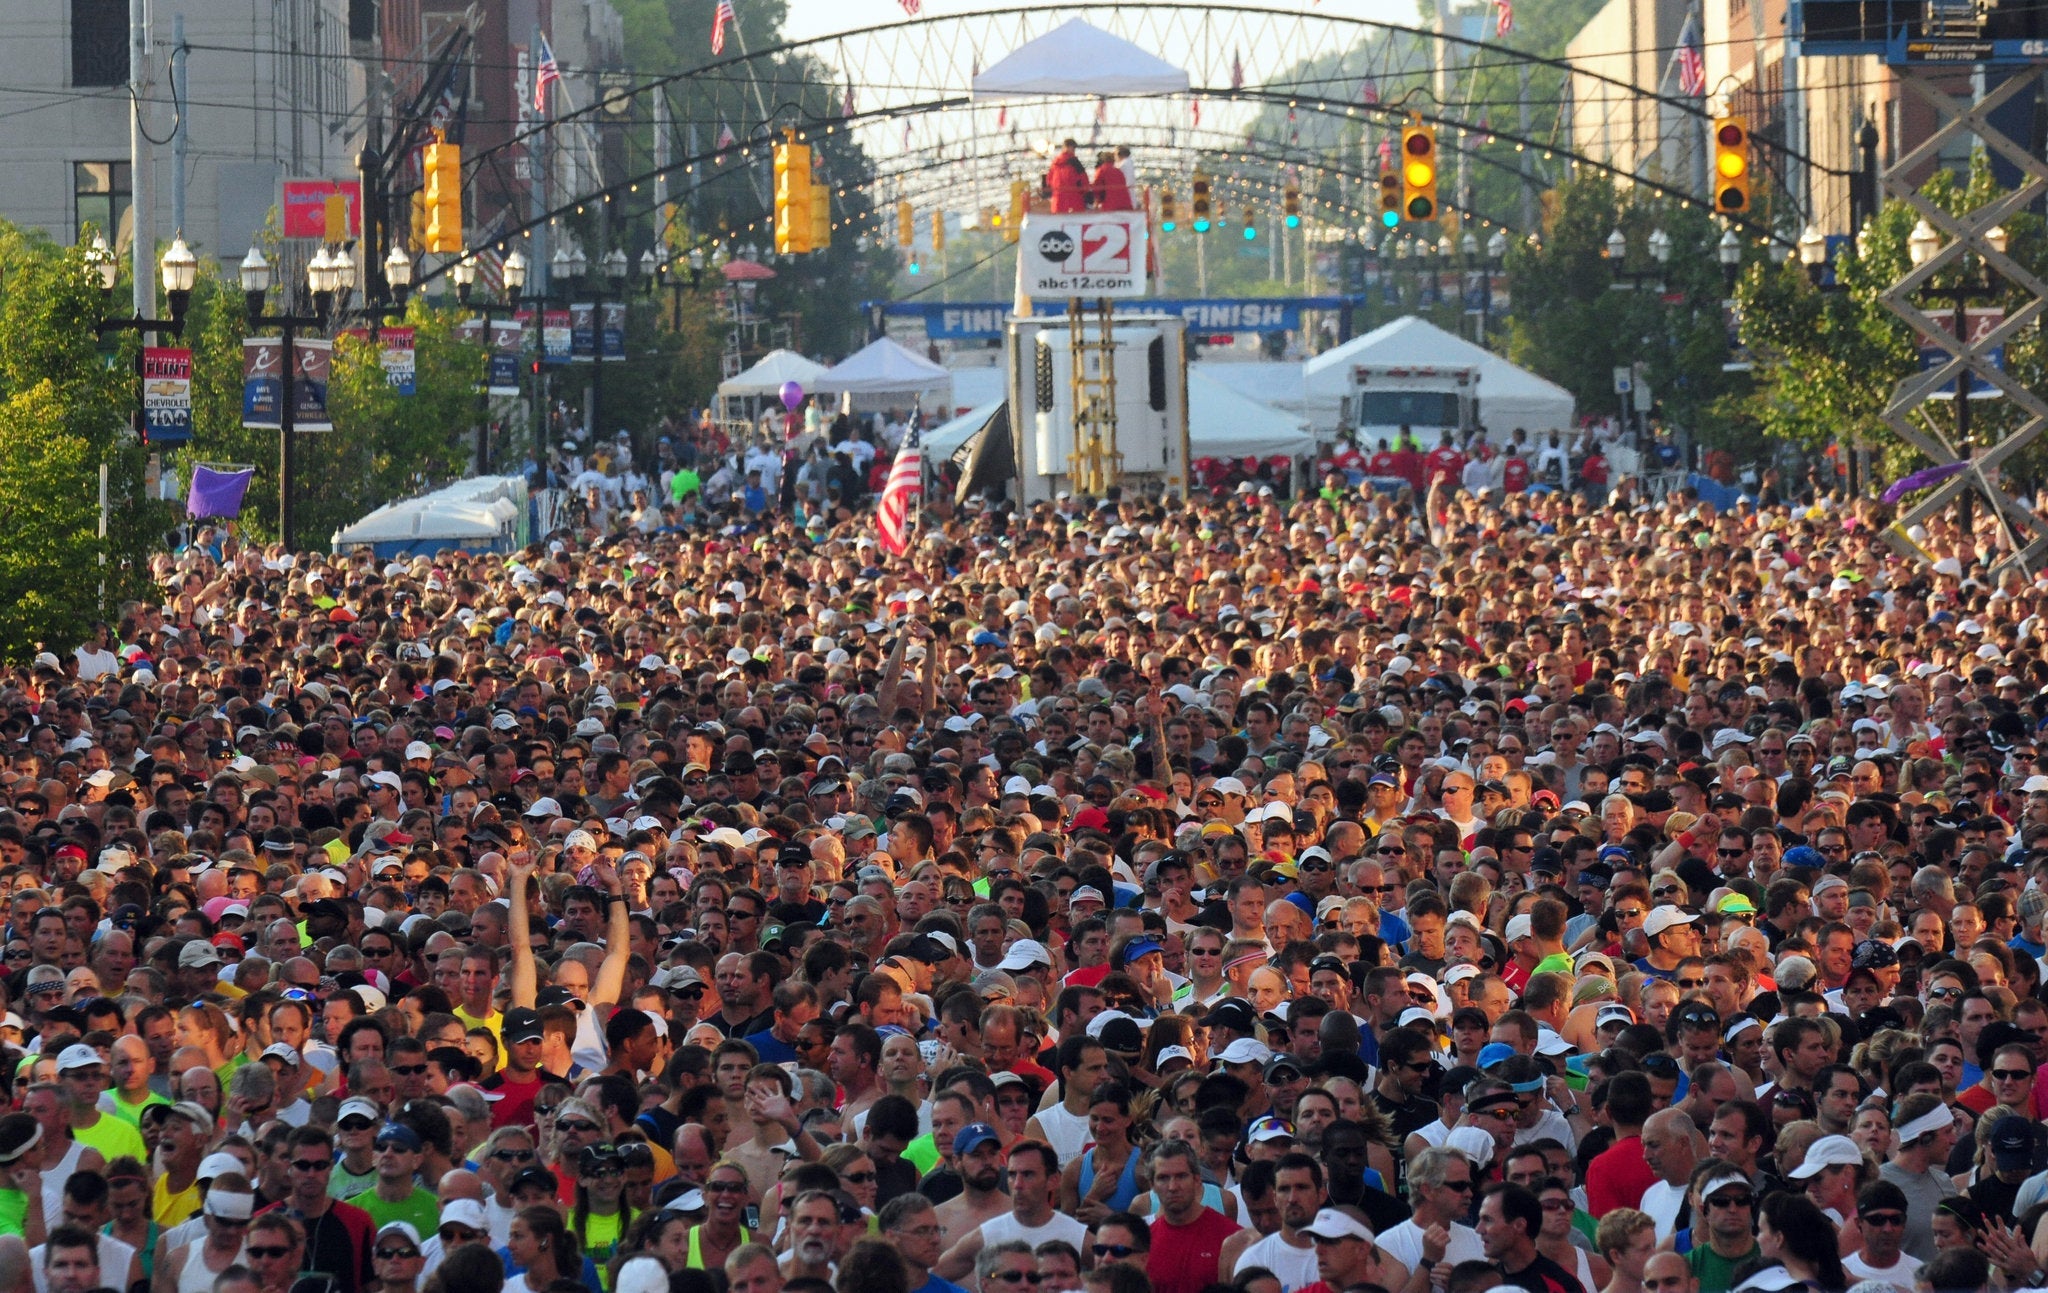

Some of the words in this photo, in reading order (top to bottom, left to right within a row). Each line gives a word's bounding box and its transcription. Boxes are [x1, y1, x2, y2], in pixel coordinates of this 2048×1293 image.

[1040, 236, 1073, 253] abc
[1038, 277, 1133, 289] abc12.com
[1181, 304, 1284, 327] FINISH
[145, 362, 189, 376] FLINT
[145, 399, 188, 408] CHEVROLET
[971, 1124, 984, 1133] T
